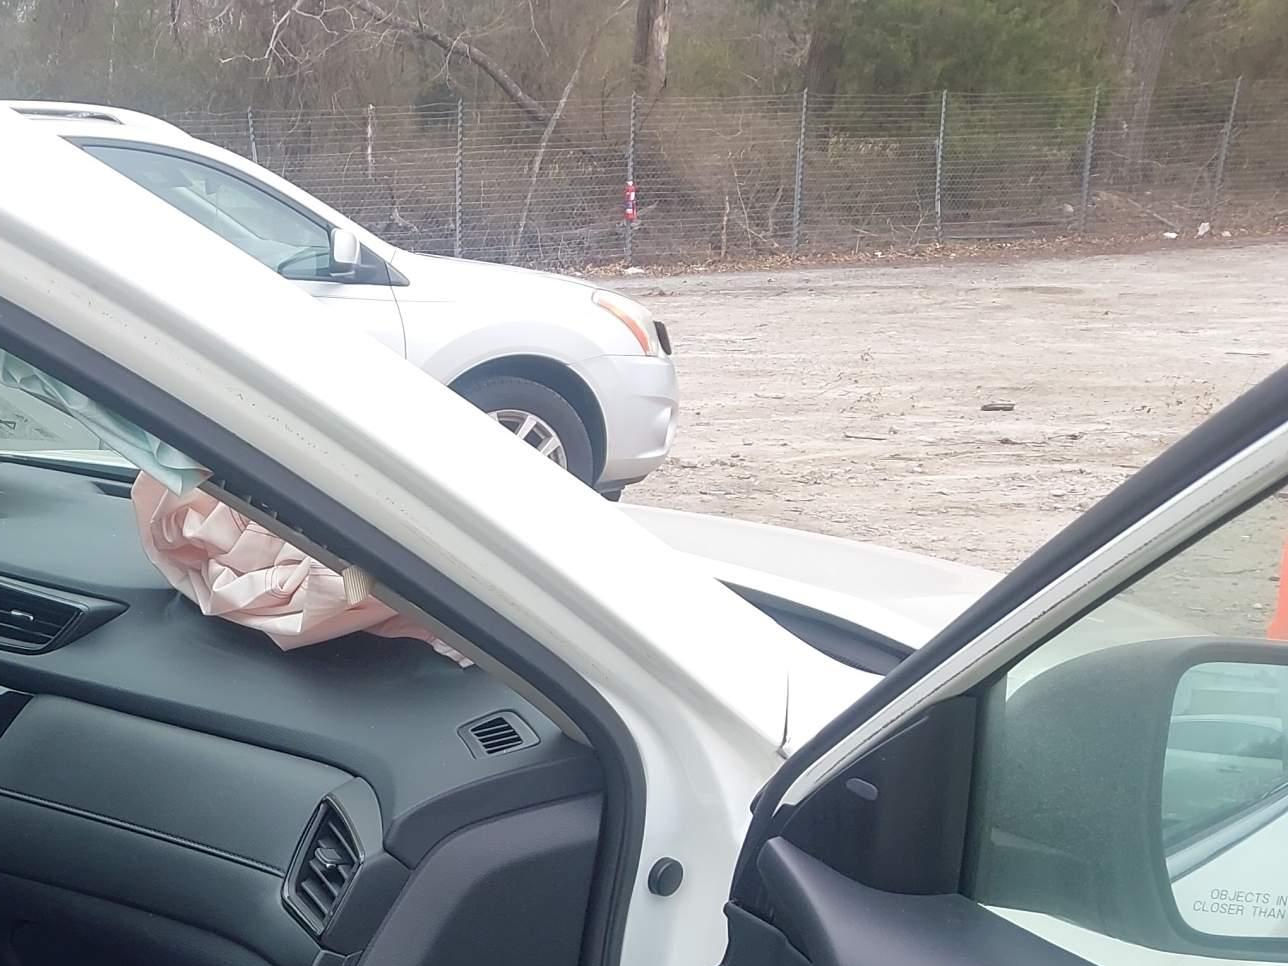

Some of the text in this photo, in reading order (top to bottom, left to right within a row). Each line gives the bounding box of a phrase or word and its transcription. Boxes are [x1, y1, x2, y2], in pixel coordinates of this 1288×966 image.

[1210, 888, 1288, 906] OBJECTS IN
[1192, 900, 1288, 919] CLOSER THAN
